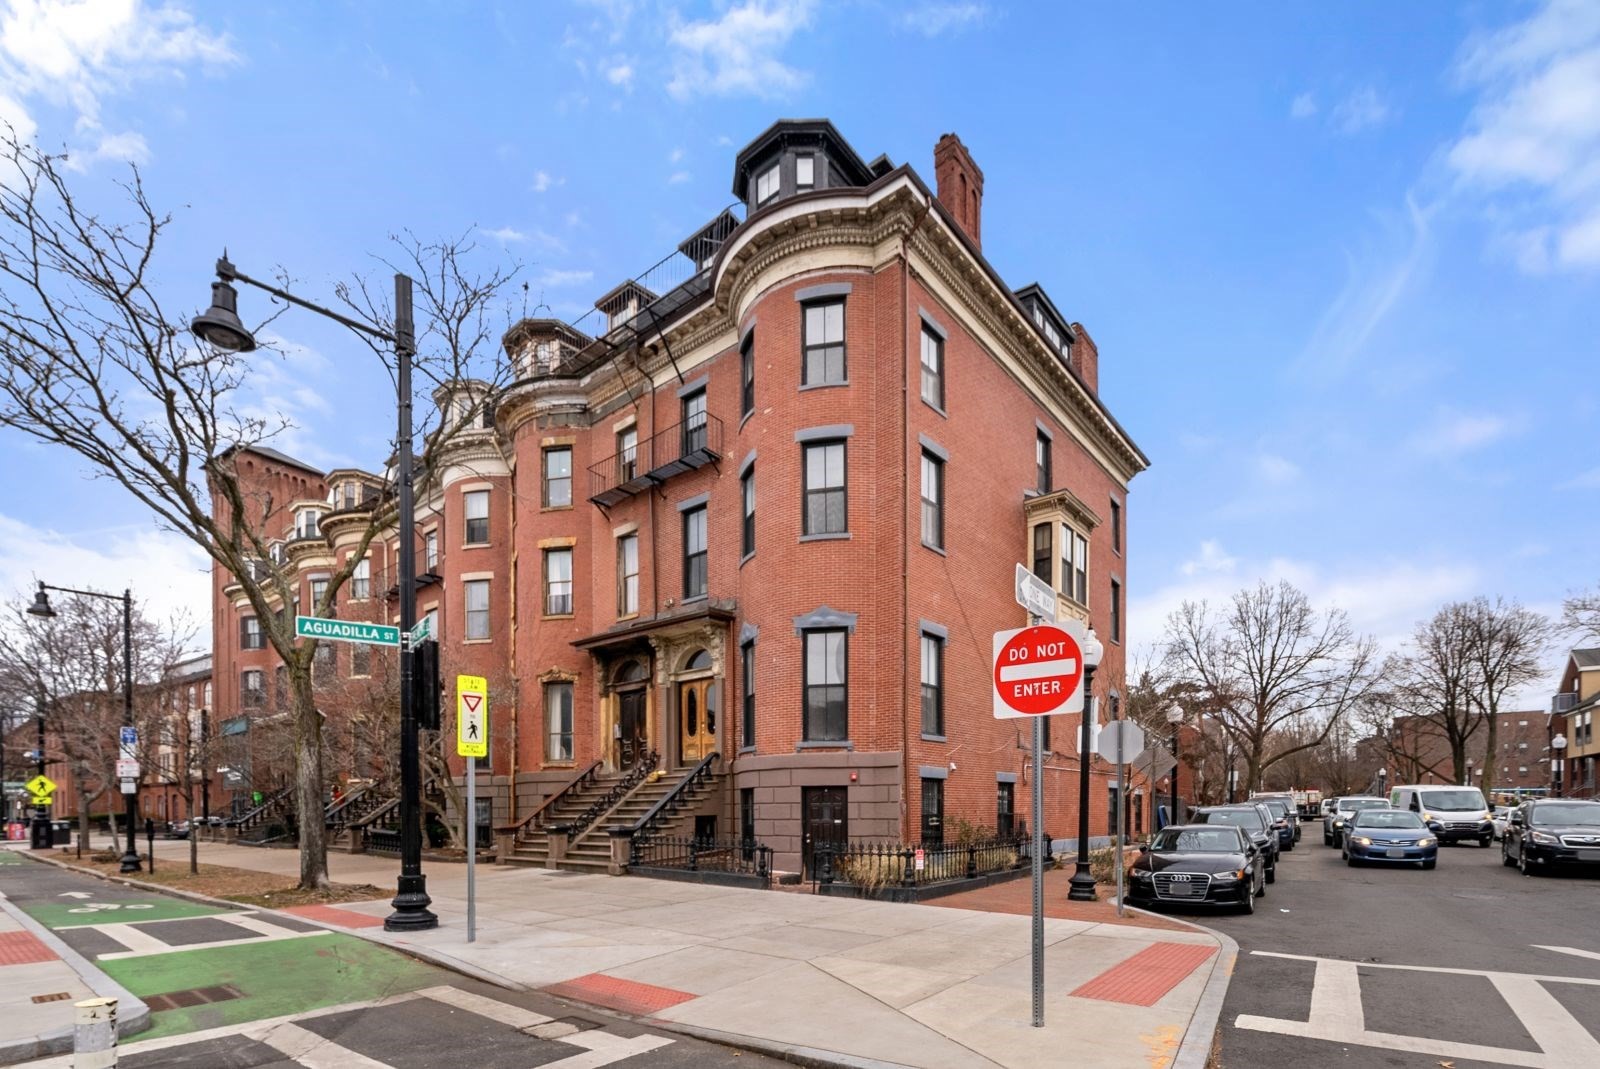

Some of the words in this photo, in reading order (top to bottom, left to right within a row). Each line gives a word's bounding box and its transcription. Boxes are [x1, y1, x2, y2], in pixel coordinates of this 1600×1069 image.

[303, 621, 380, 639] AGUADILLA
[384, 632, 394, 640] ST
[1009, 647, 1028, 661] DO
[1037, 642, 1066, 658] NOT
[1014, 681, 1060, 698] ENTER
